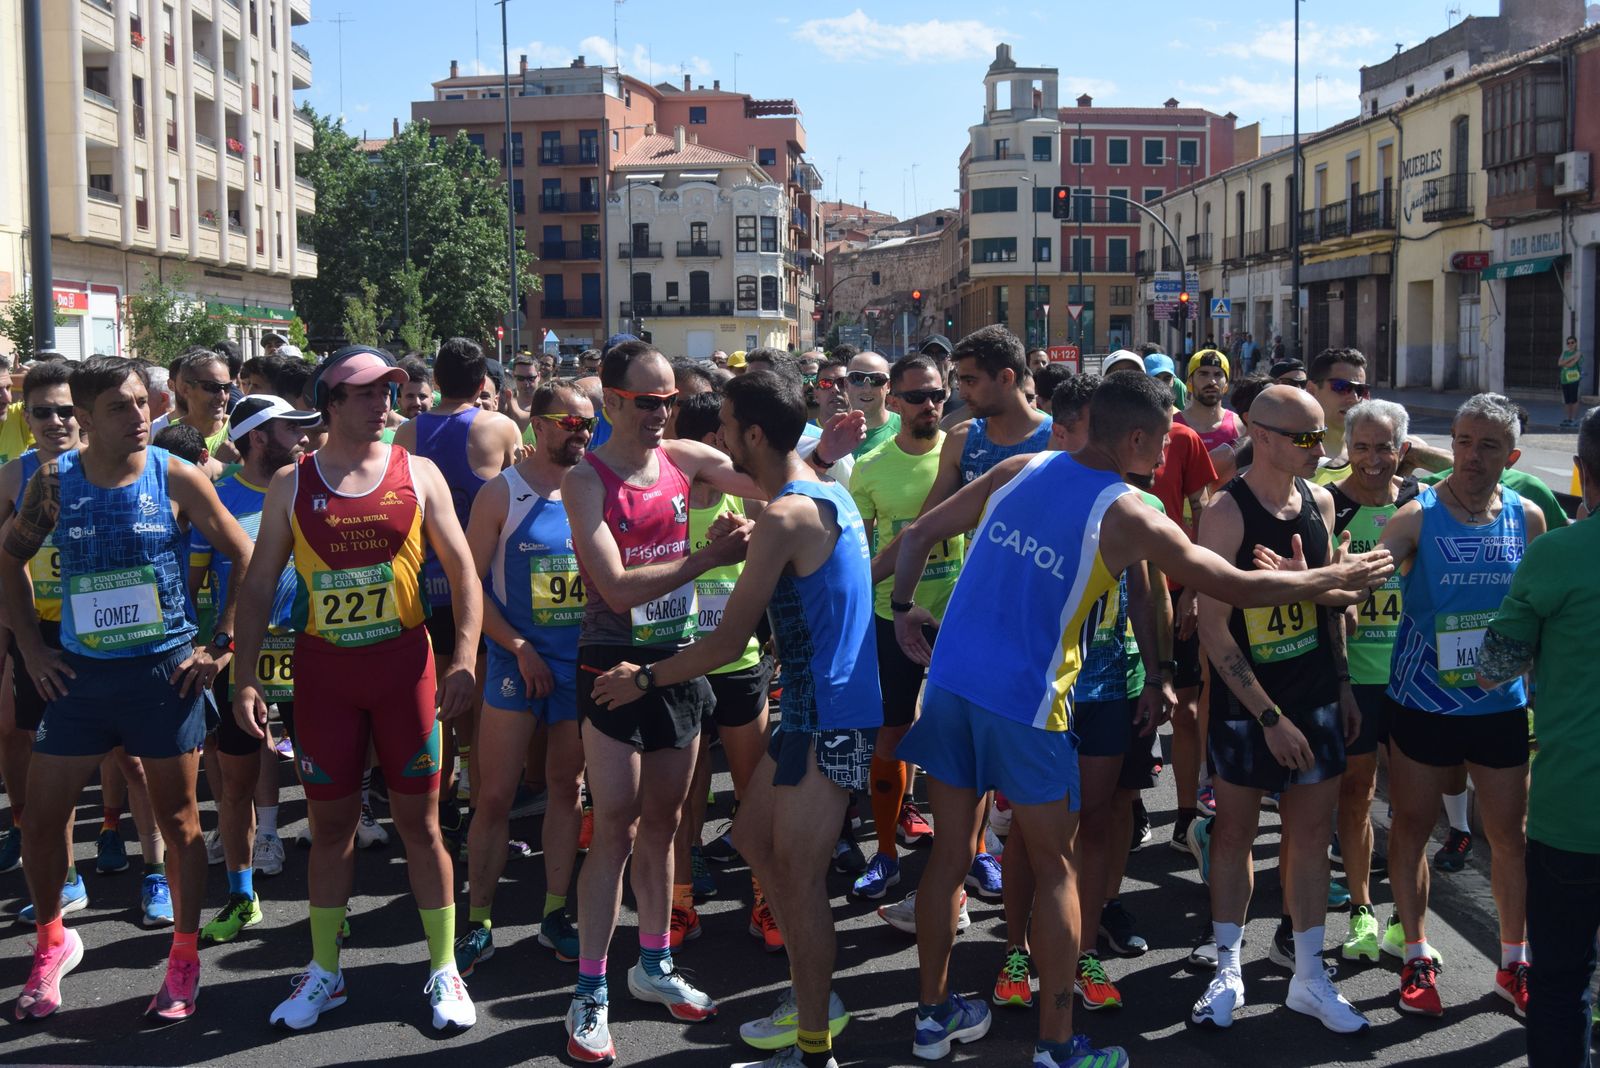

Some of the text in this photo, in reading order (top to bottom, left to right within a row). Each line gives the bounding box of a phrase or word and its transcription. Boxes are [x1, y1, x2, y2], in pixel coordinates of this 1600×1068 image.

[1402, 149, 1442, 181] MUEBLES
[1510, 232, 1560, 256] BAR ANGLO
[1496, 263, 1534, 279] BAR ANGLO
[1051, 350, 1076, 360] N-122
[342, 513, 389, 524] CAJA RURAL
[341, 528, 376, 541] VINO
[1484, 536, 1523, 545] COMERCIAL
[330, 538, 389, 553] DE TORO
[988, 521, 1065, 580] CAPOL
[1484, 545, 1523, 562] ULSA
[93, 570, 142, 584] FUNDACION
[334, 567, 382, 580] FUNDACION
[356, 576, 383, 585] RURAL
[116, 578, 144, 587] RURAL
[550, 574, 584, 604] 94
[322, 587, 387, 624] 227
[646, 596, 687, 621] GARGAR
[1361, 594, 1400, 621] 44
[94, 604, 140, 628] GOMEZ
[698, 609, 725, 627] ORG
[1267, 602, 1303, 635] 49
[127, 628, 160, 640] RURAL
[365, 626, 397, 639] RURAL
[1297, 635, 1317, 648] RURAL
